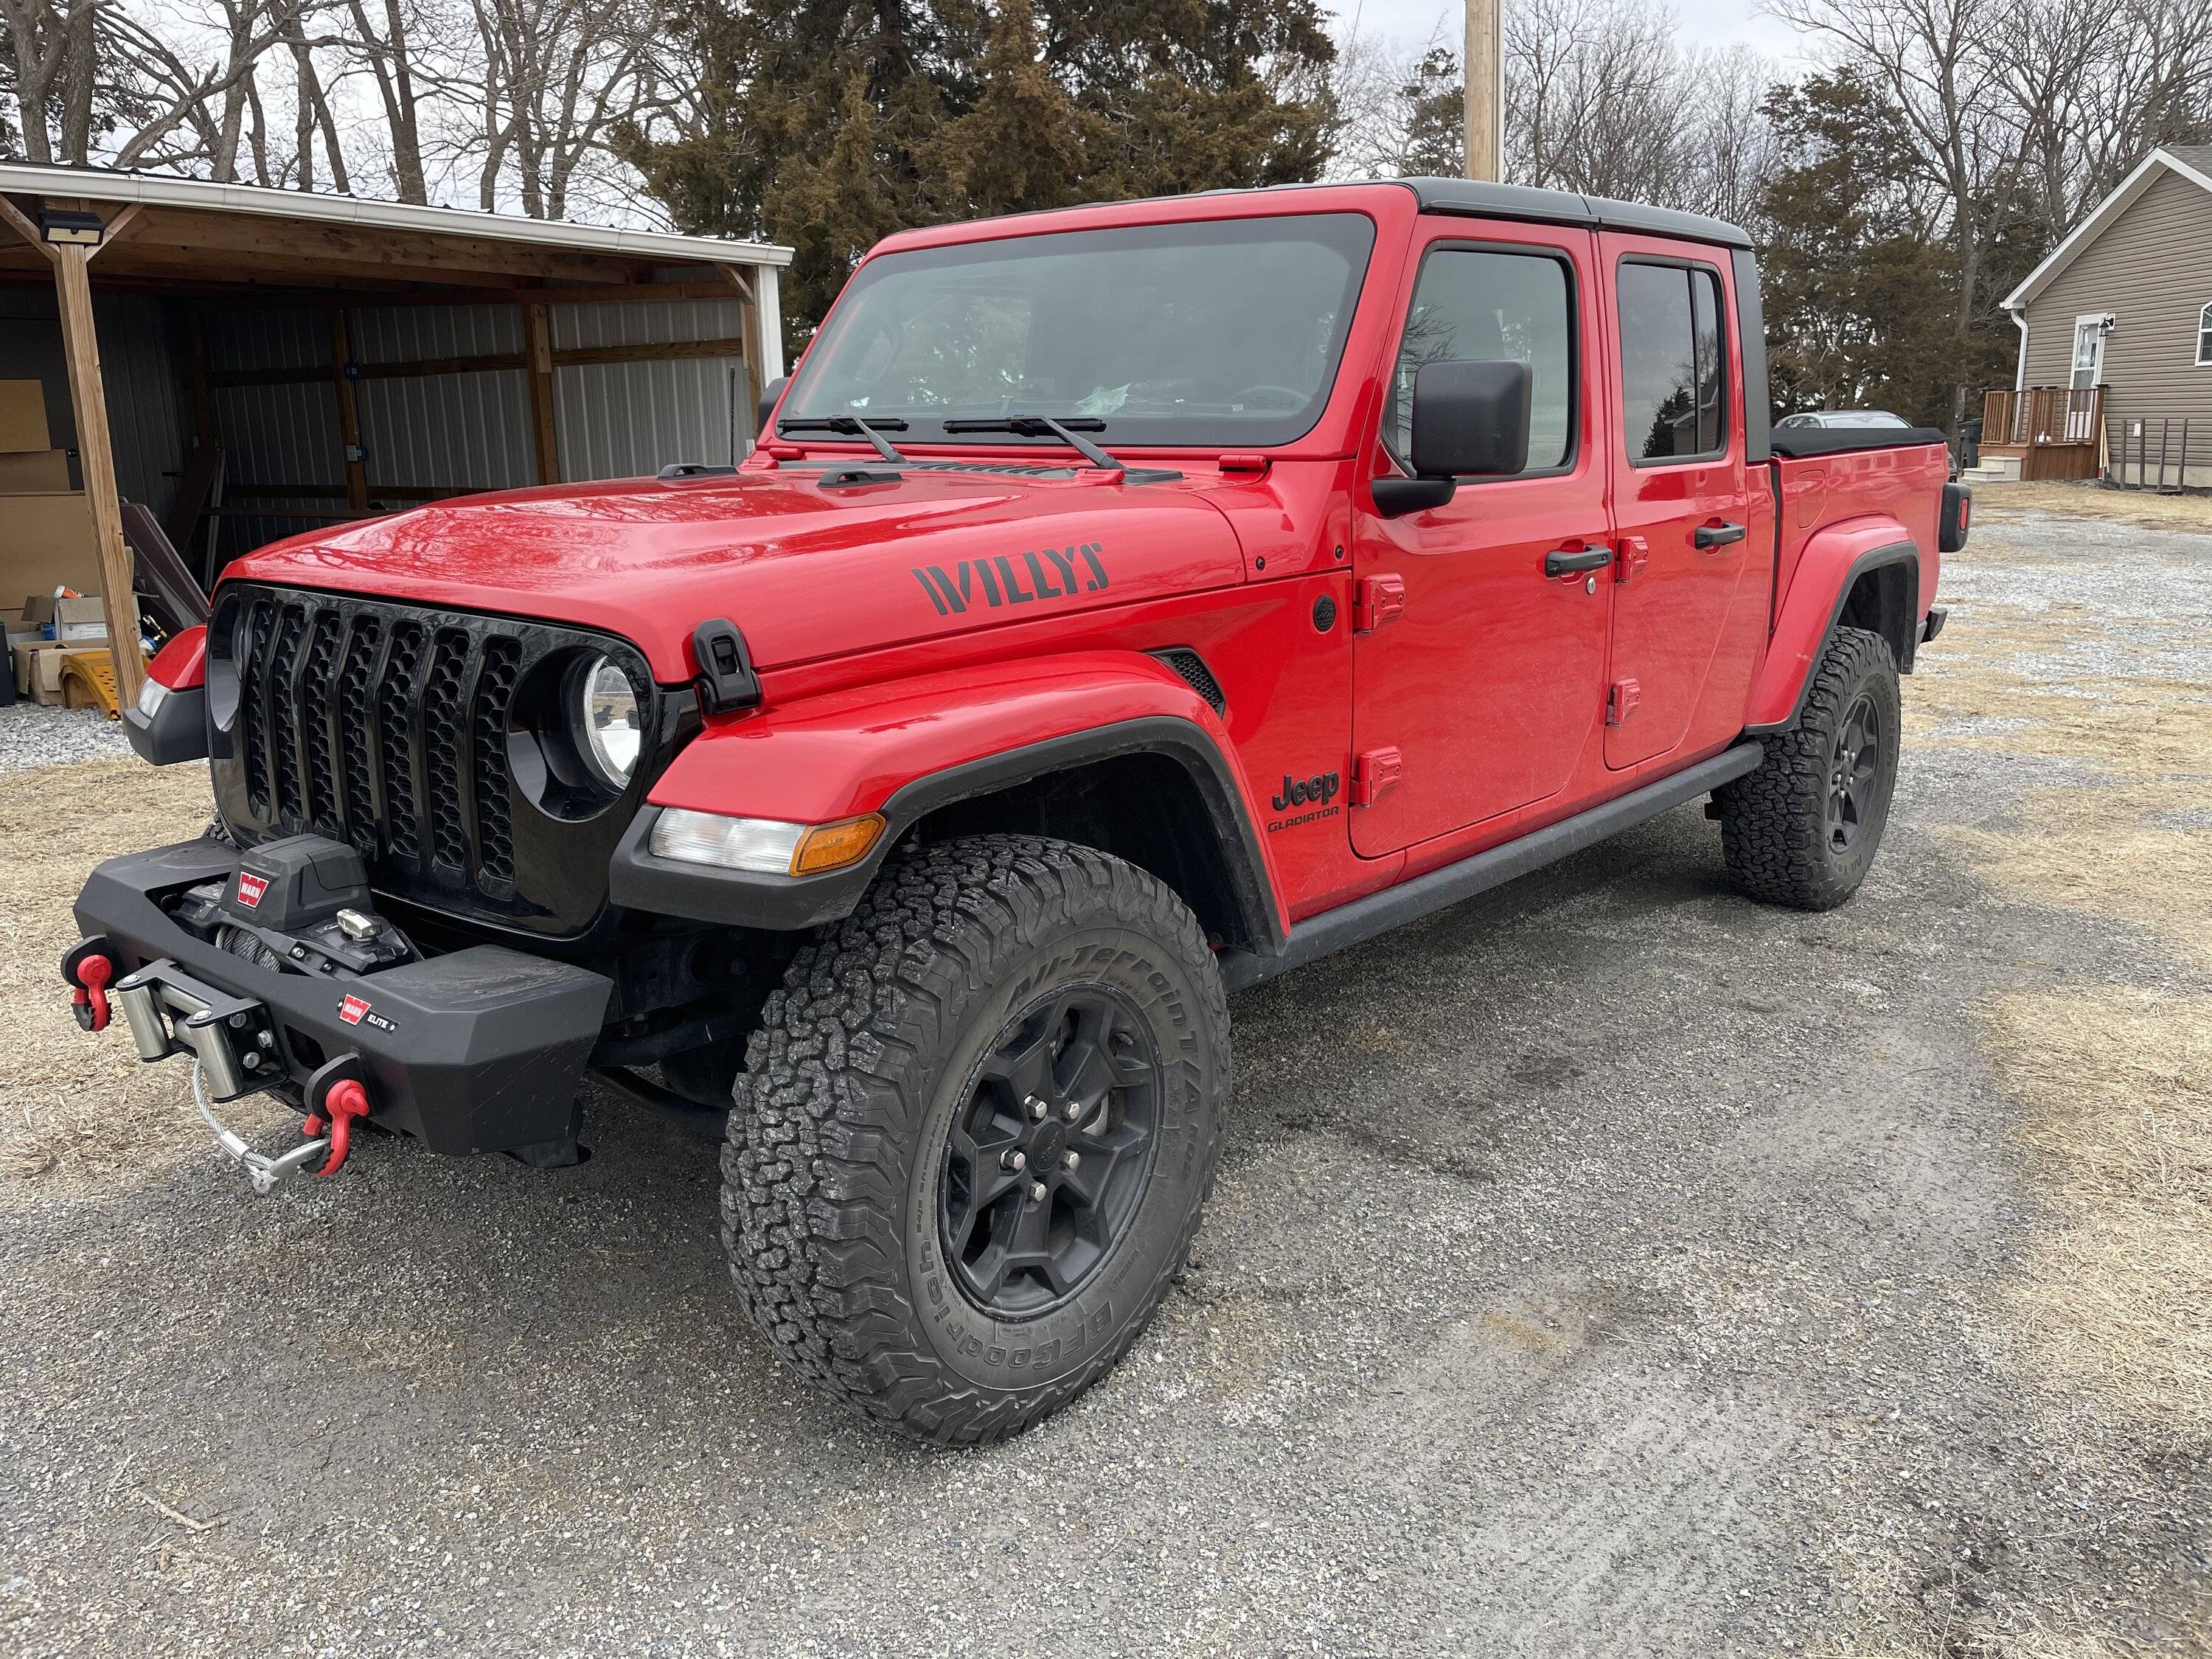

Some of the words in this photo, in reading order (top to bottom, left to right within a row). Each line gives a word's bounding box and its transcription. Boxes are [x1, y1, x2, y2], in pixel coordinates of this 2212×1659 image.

[910, 542, 1109, 616] WILLYS
[1272, 771, 1339, 811] Jeep
[1267, 806, 1340, 833] GLADIATOR
[240, 882, 261, 899] WARN
[367, 1014, 389, 1029] ELITE
